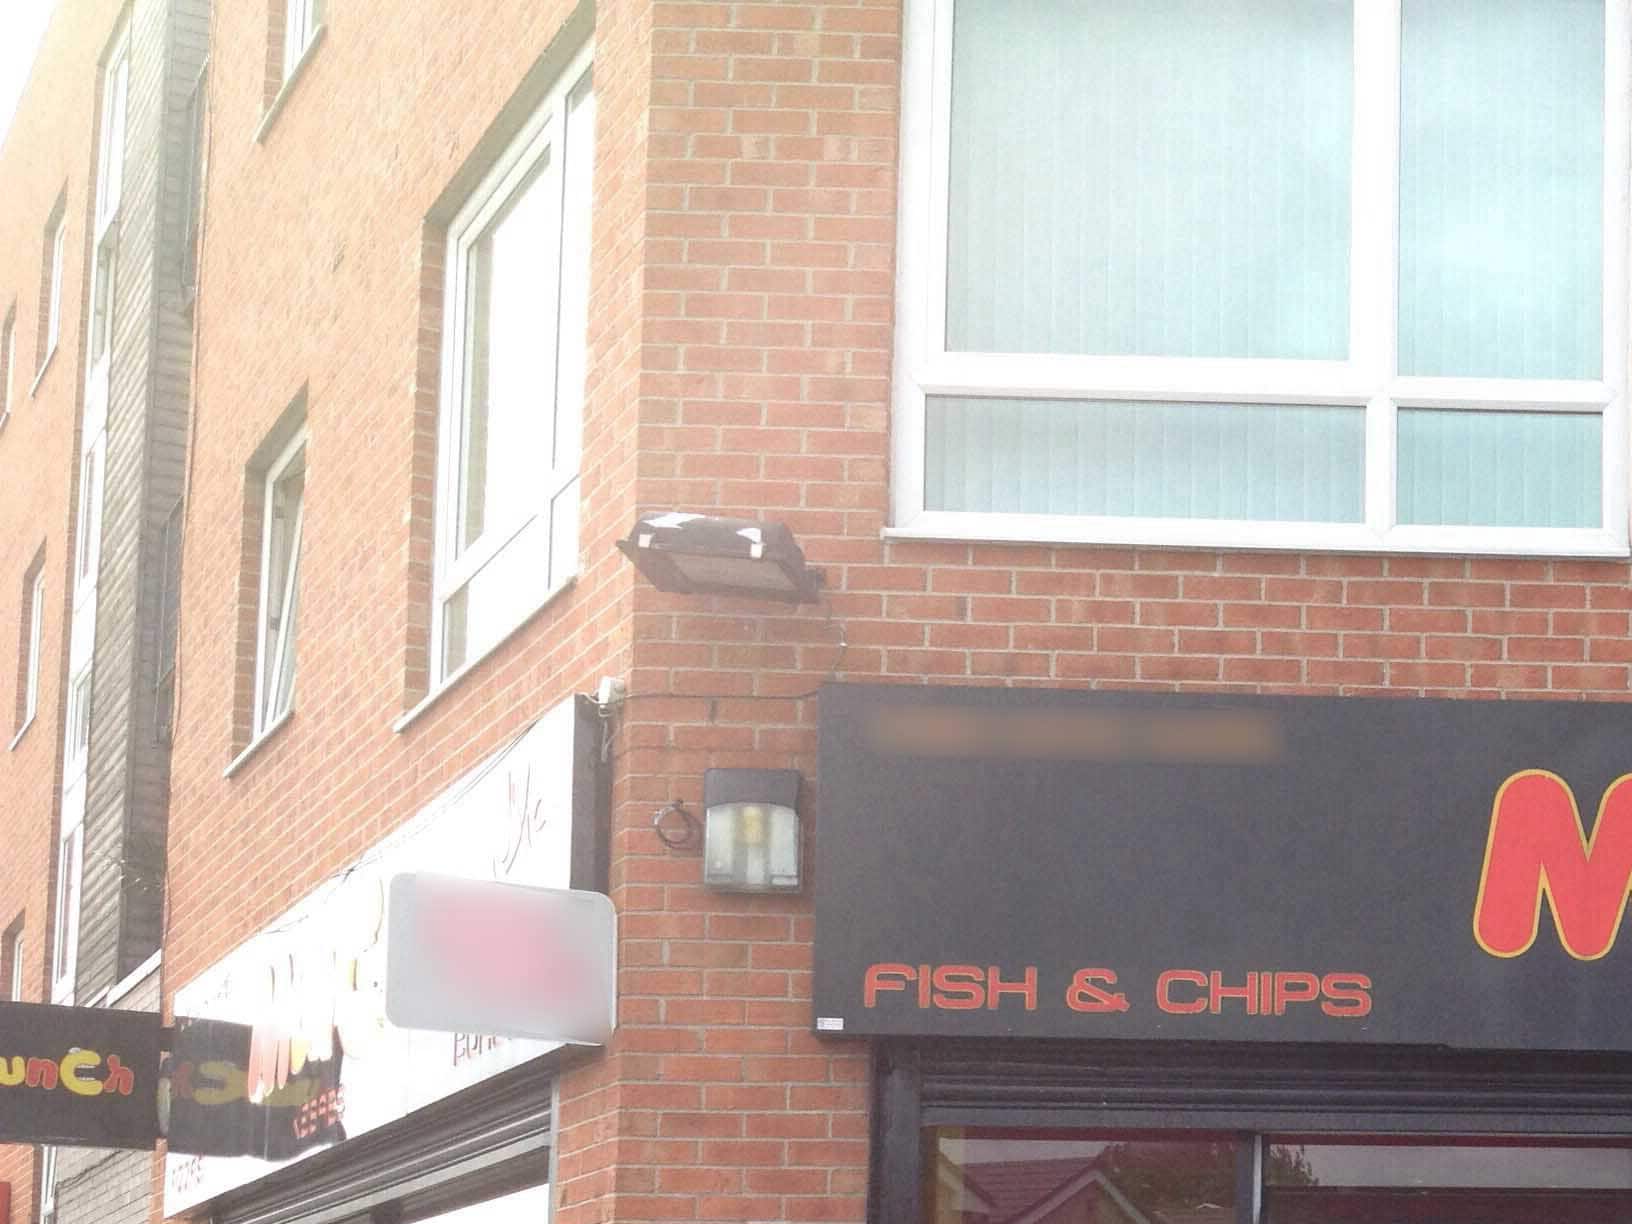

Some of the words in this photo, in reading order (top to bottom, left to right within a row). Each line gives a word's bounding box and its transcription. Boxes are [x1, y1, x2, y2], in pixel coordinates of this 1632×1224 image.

[863, 963, 1038, 1010] FISH
[1066, 968, 1131, 1013] &
[1156, 969, 1373, 1017] CHIPS
[0, 1046, 135, 1096] unCh
